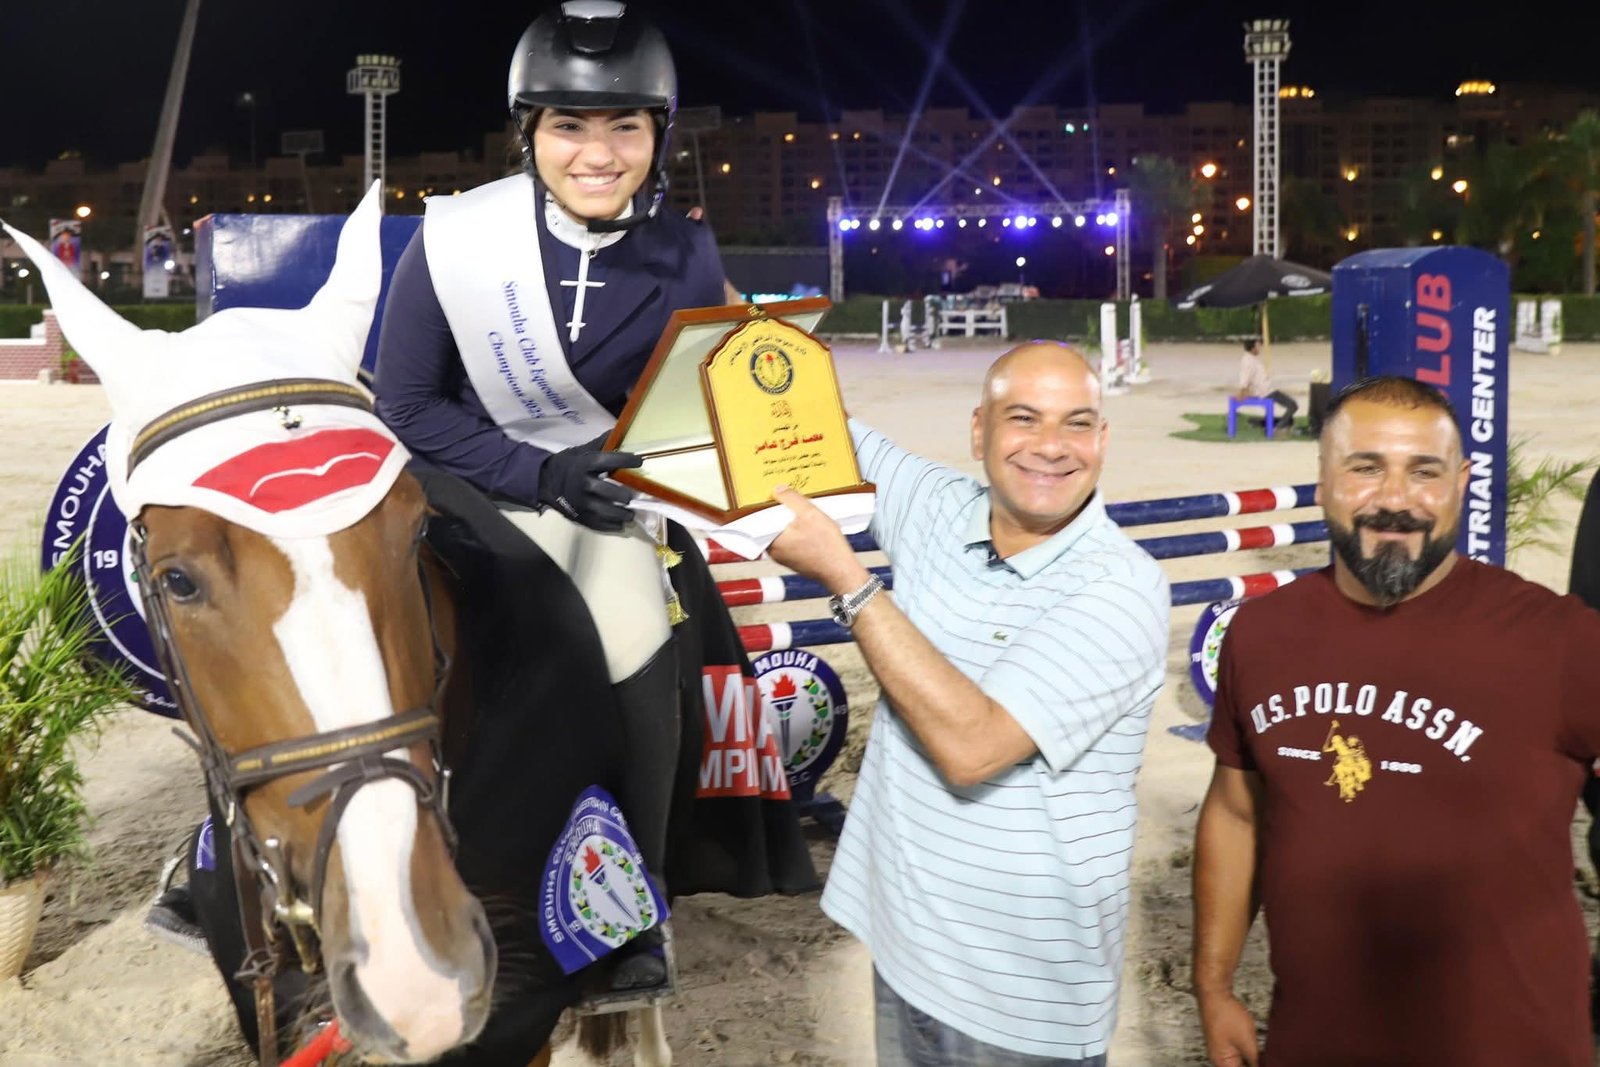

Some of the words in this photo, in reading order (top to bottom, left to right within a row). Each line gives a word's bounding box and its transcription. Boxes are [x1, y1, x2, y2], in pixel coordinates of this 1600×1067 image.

[502, 281, 528, 335] Smouha
[518, 338, 540, 366] Club
[1415, 273, 1452, 398] LUB
[487, 331, 525, 398] Champions
[1471, 306, 1496, 443] CENTER
[94, 550, 118, 569] 19
[754, 651, 819, 675] MOUHA
[1250, 694, 1292, 734] U.S.
[1293, 682, 1377, 717] POLO
[1381, 690, 1484, 763] ASSN.
[1277, 746, 1322, 761] SINCE
[544, 869, 566, 944] SMOUHA
